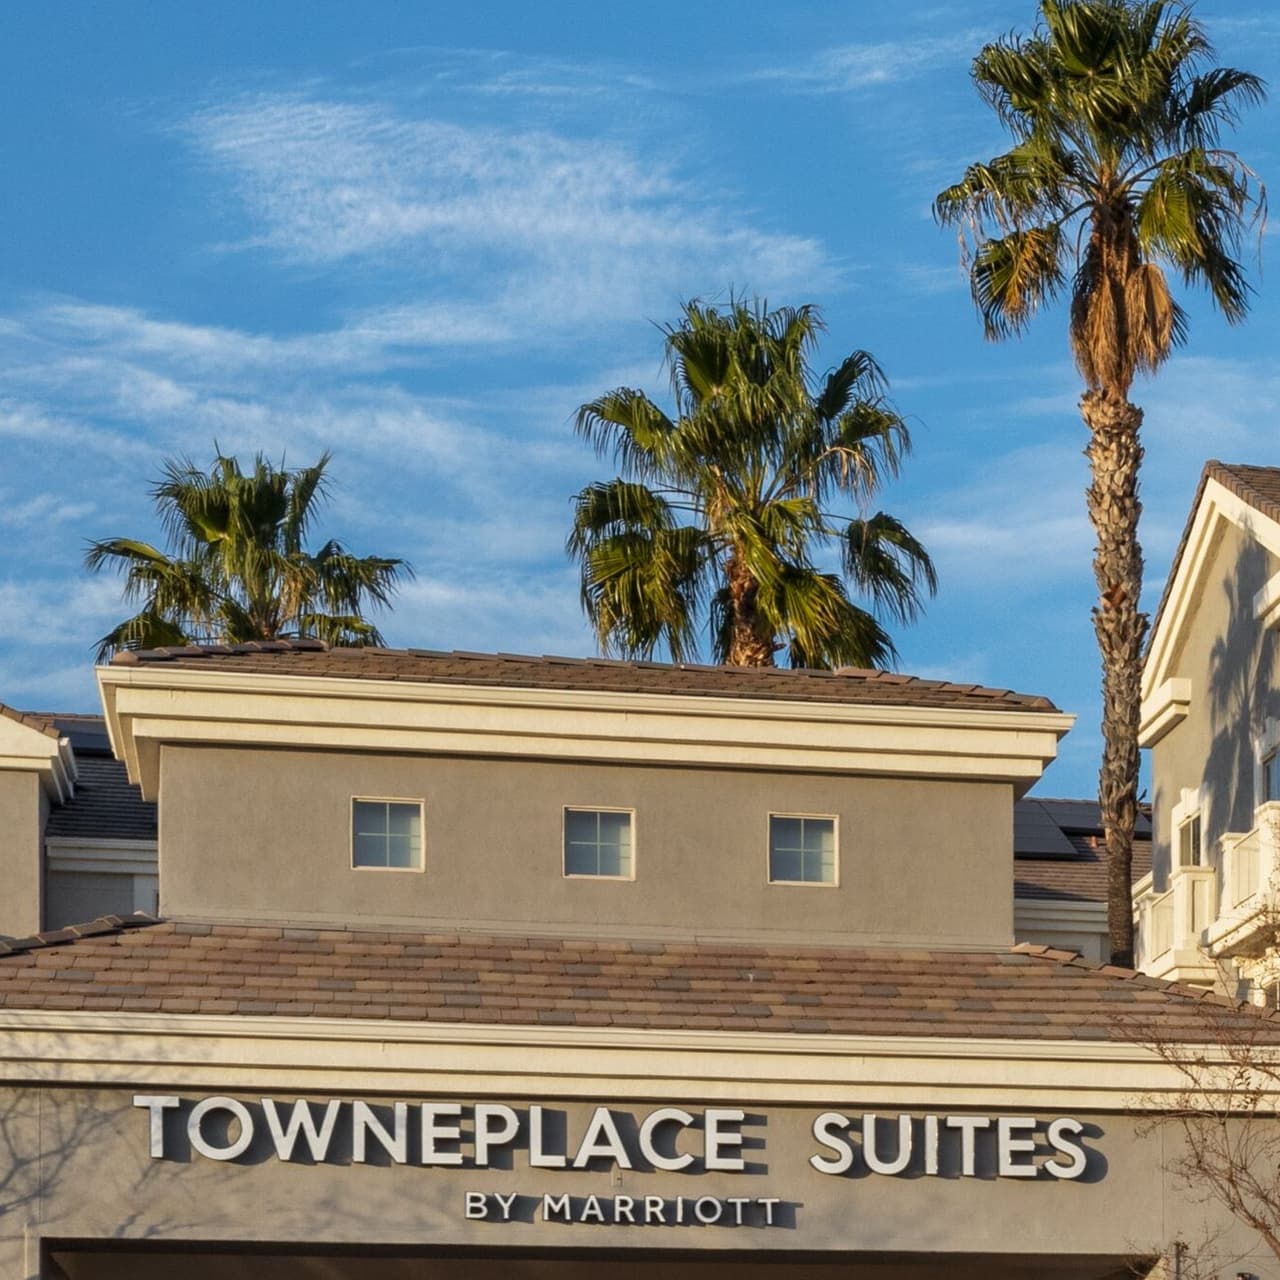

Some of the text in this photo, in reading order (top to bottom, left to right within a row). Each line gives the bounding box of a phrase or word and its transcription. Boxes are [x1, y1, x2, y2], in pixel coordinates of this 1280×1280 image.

[132, 1094, 1088, 1179] TOWNEPLACE SUITES
[464, 1191, 781, 1225] BY MARRIOTT
